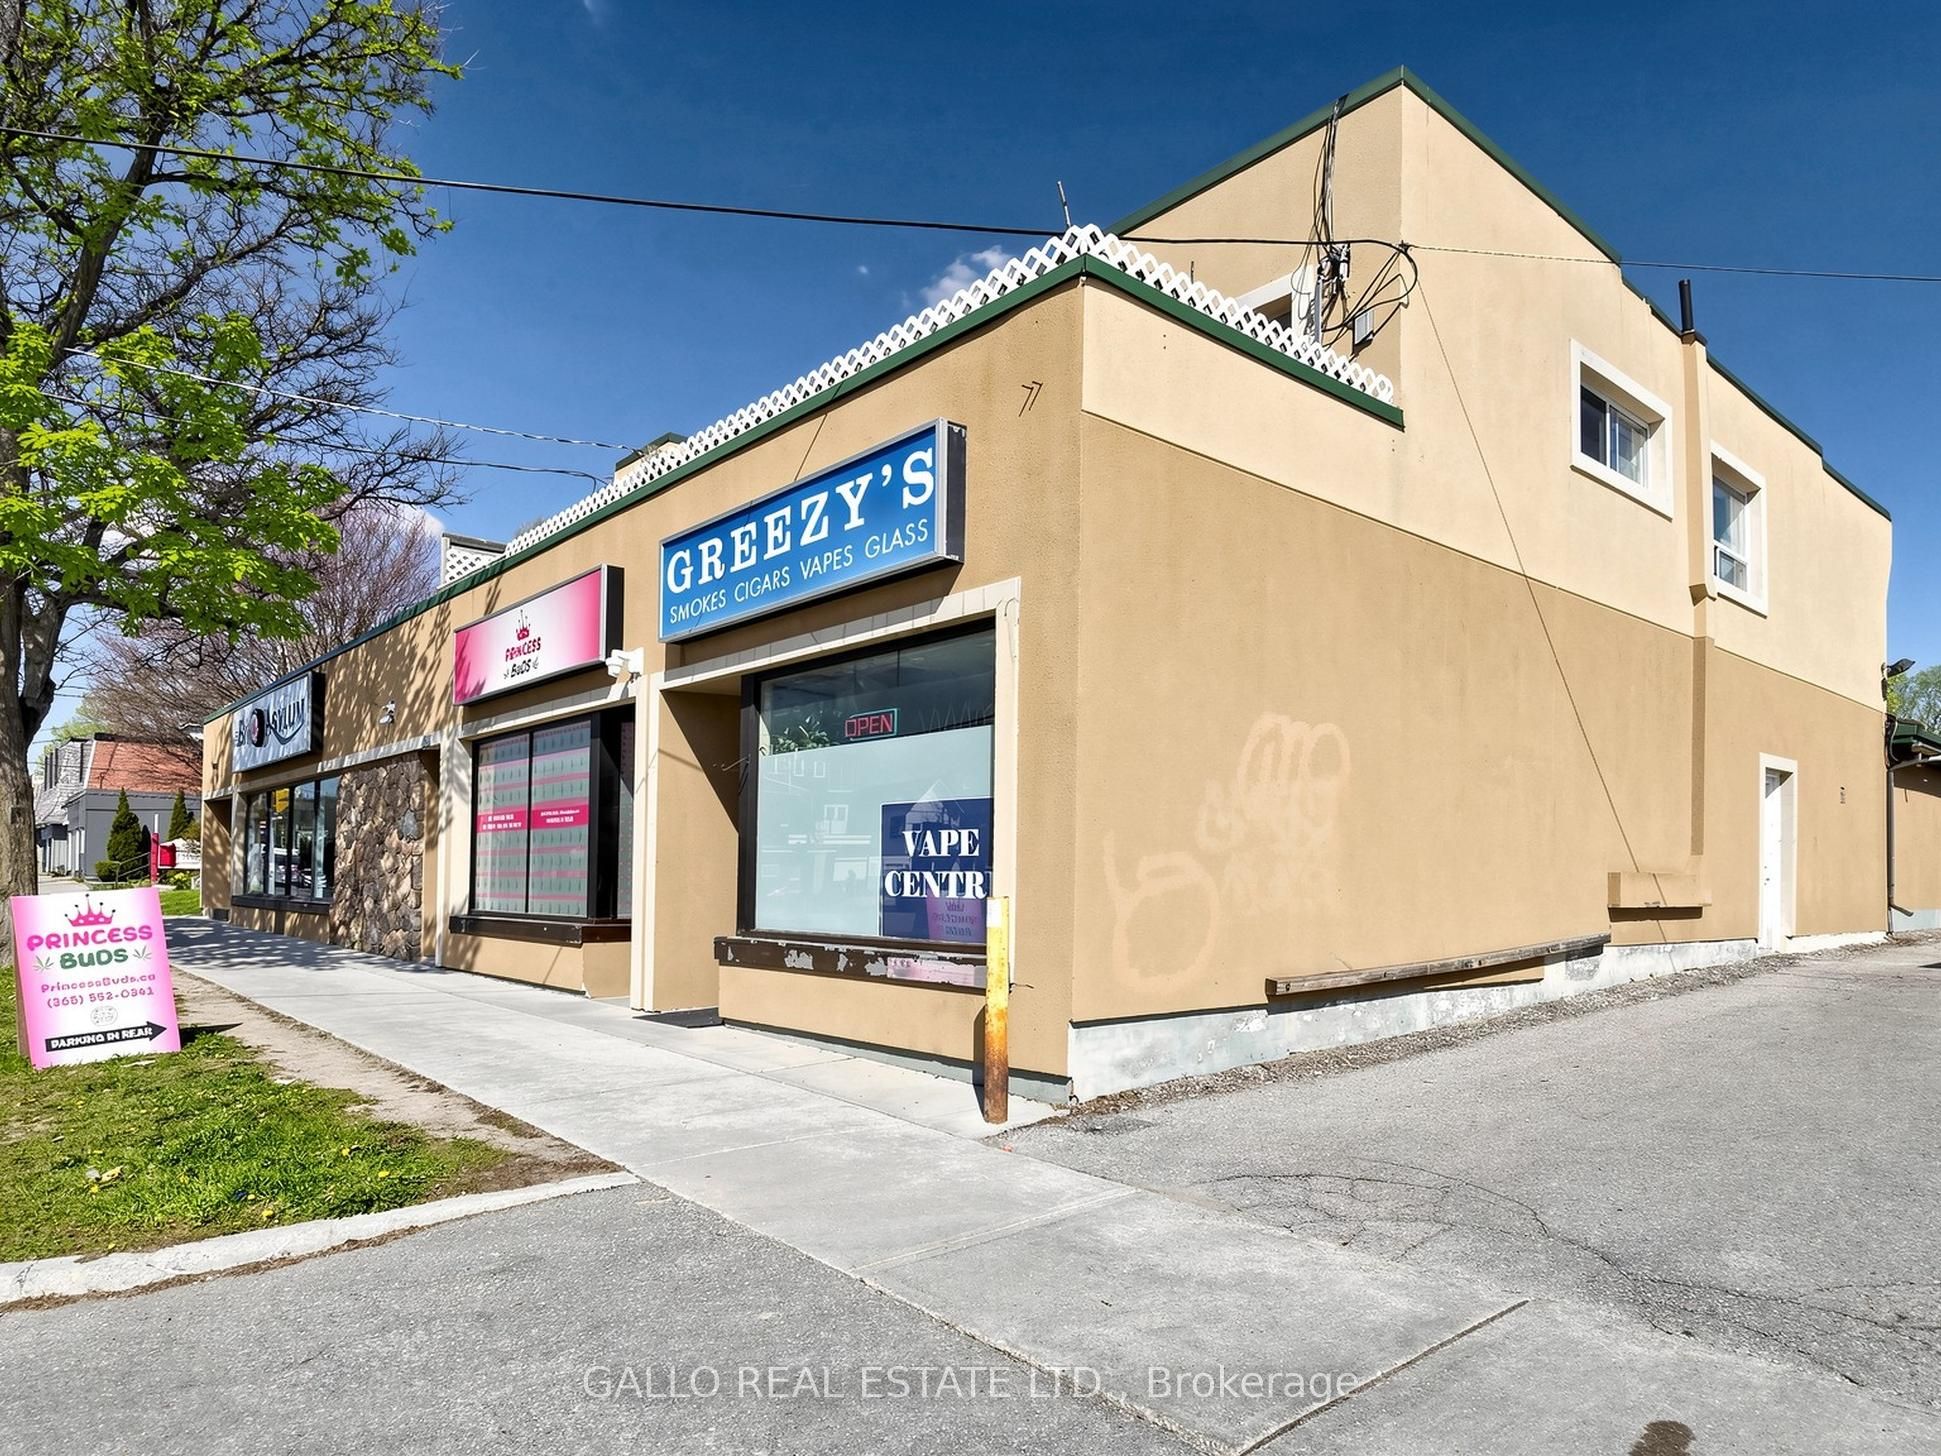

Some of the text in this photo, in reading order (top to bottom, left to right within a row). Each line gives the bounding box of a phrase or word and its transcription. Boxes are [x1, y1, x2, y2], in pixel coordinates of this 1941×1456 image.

[666, 447, 936, 594] GREEZY'S
[669, 519, 929, 624] SMOKES CIGARS VAPES GLASS
[845, 714, 893, 737] OPEN
[903, 829, 979, 857] VAPE
[884, 871, 993, 900] CENTR
[26, 925, 153, 952] PRINCESS
[50, 1034, 106, 1050] PARKING
[121, 1026, 153, 1041] REAR
